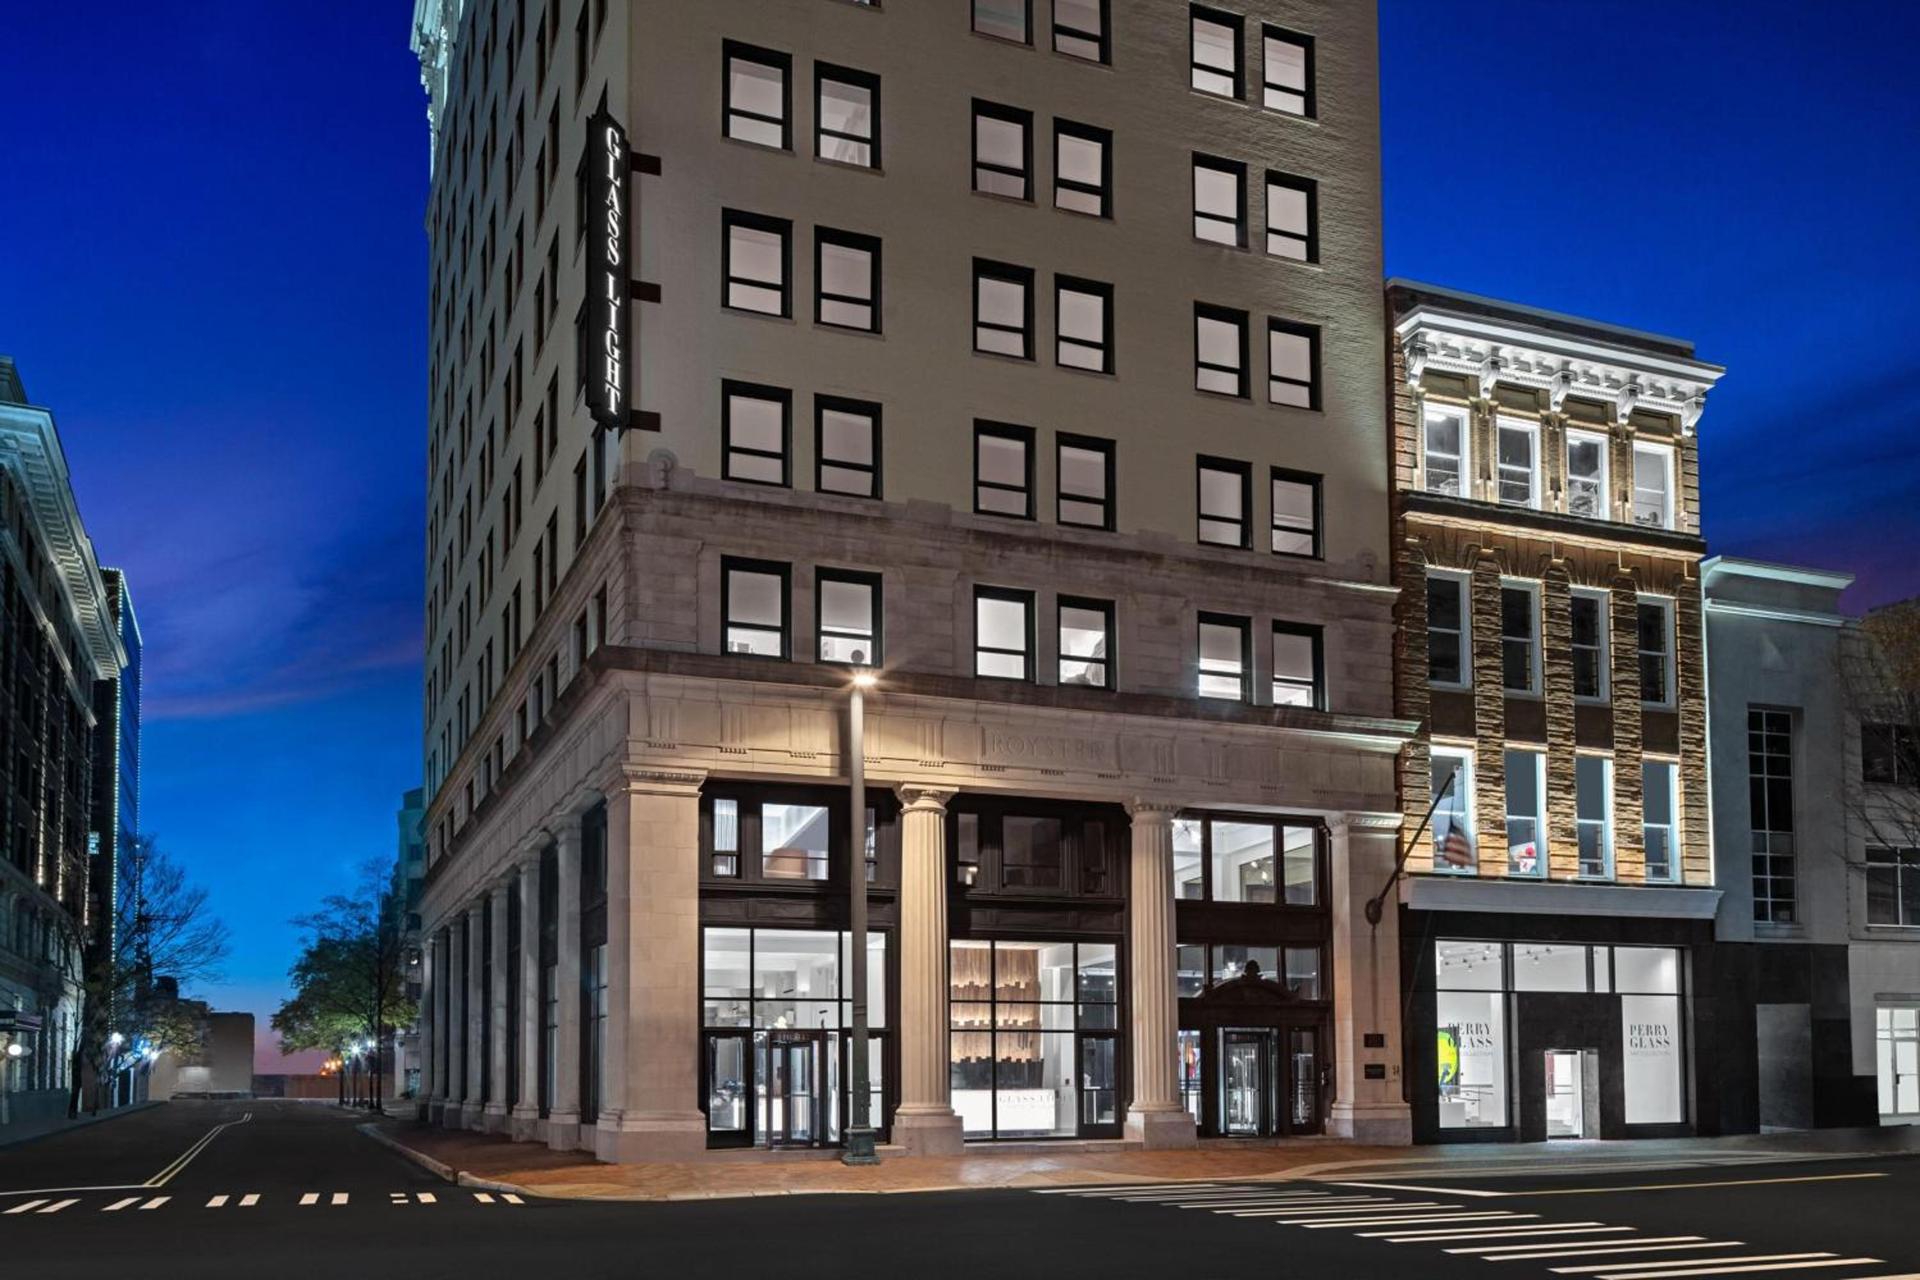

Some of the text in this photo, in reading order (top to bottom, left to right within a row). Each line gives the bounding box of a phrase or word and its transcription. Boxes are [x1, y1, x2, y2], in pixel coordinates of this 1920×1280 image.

[605, 127, 620, 416] GLASS LIGHT
[992, 735, 1105, 760] ROYSTER
[1628, 1024, 1669, 1036] PERRY
[1628, 1036, 1671, 1048] GLASS
